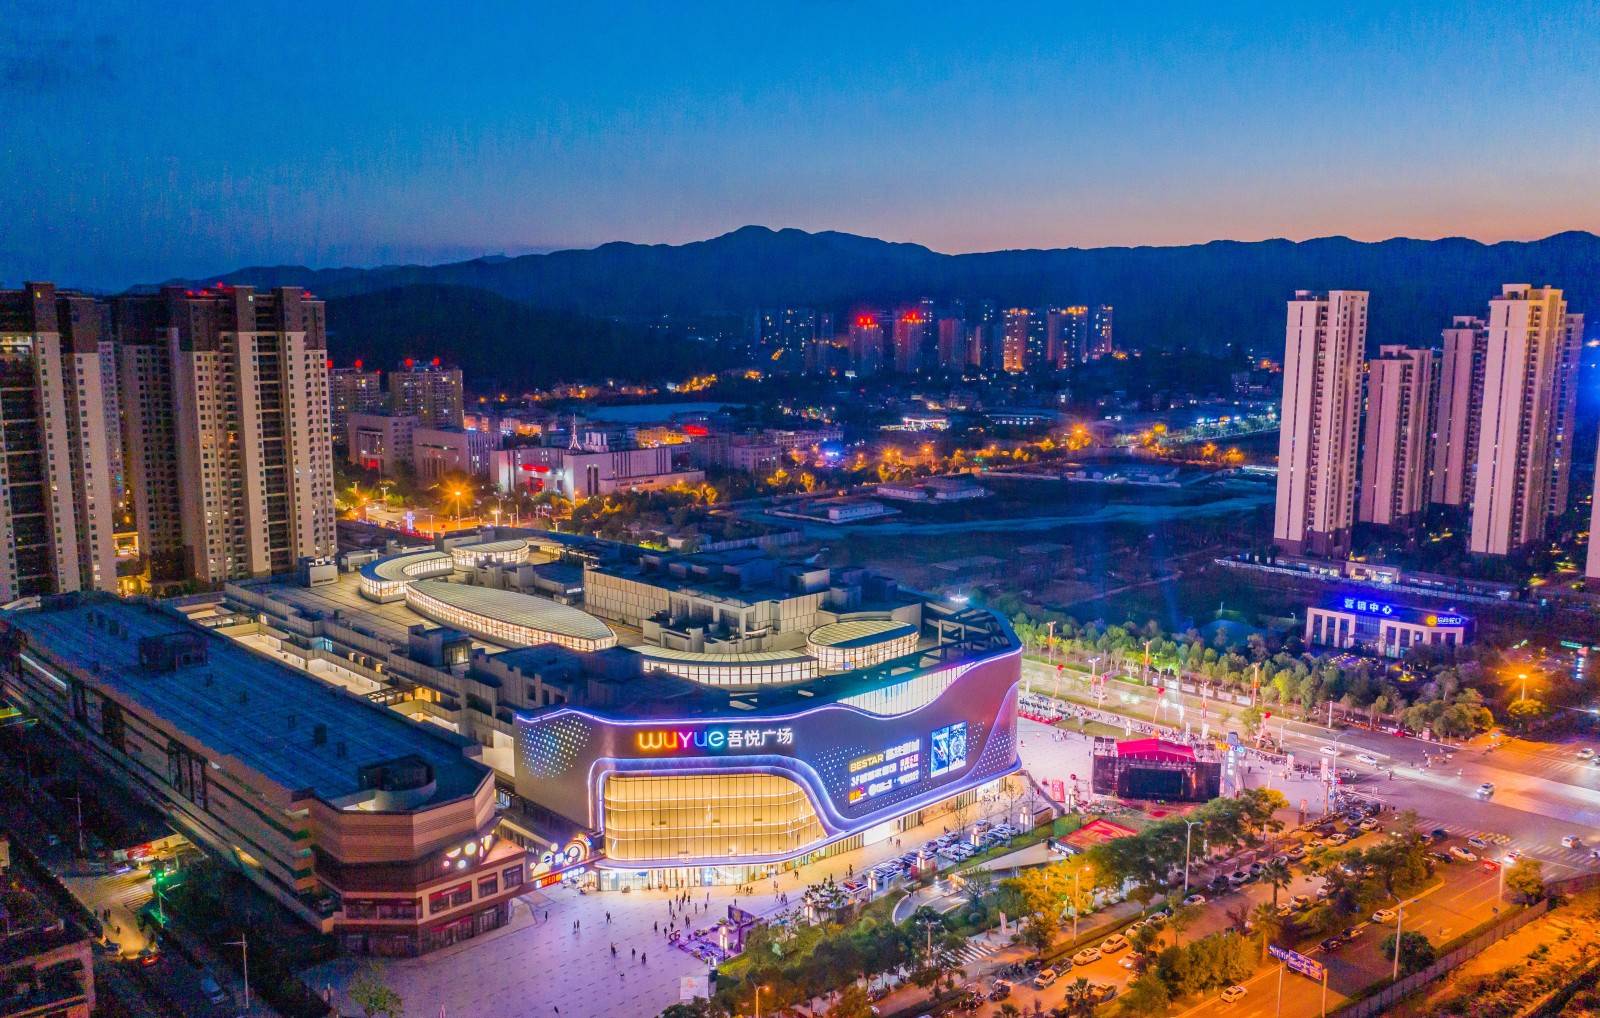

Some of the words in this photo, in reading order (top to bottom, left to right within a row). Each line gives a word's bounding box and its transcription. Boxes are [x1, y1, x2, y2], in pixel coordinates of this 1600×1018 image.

[727, 728, 794, 748] 吾悦广场
[850, 753, 884, 773] BESTAR
